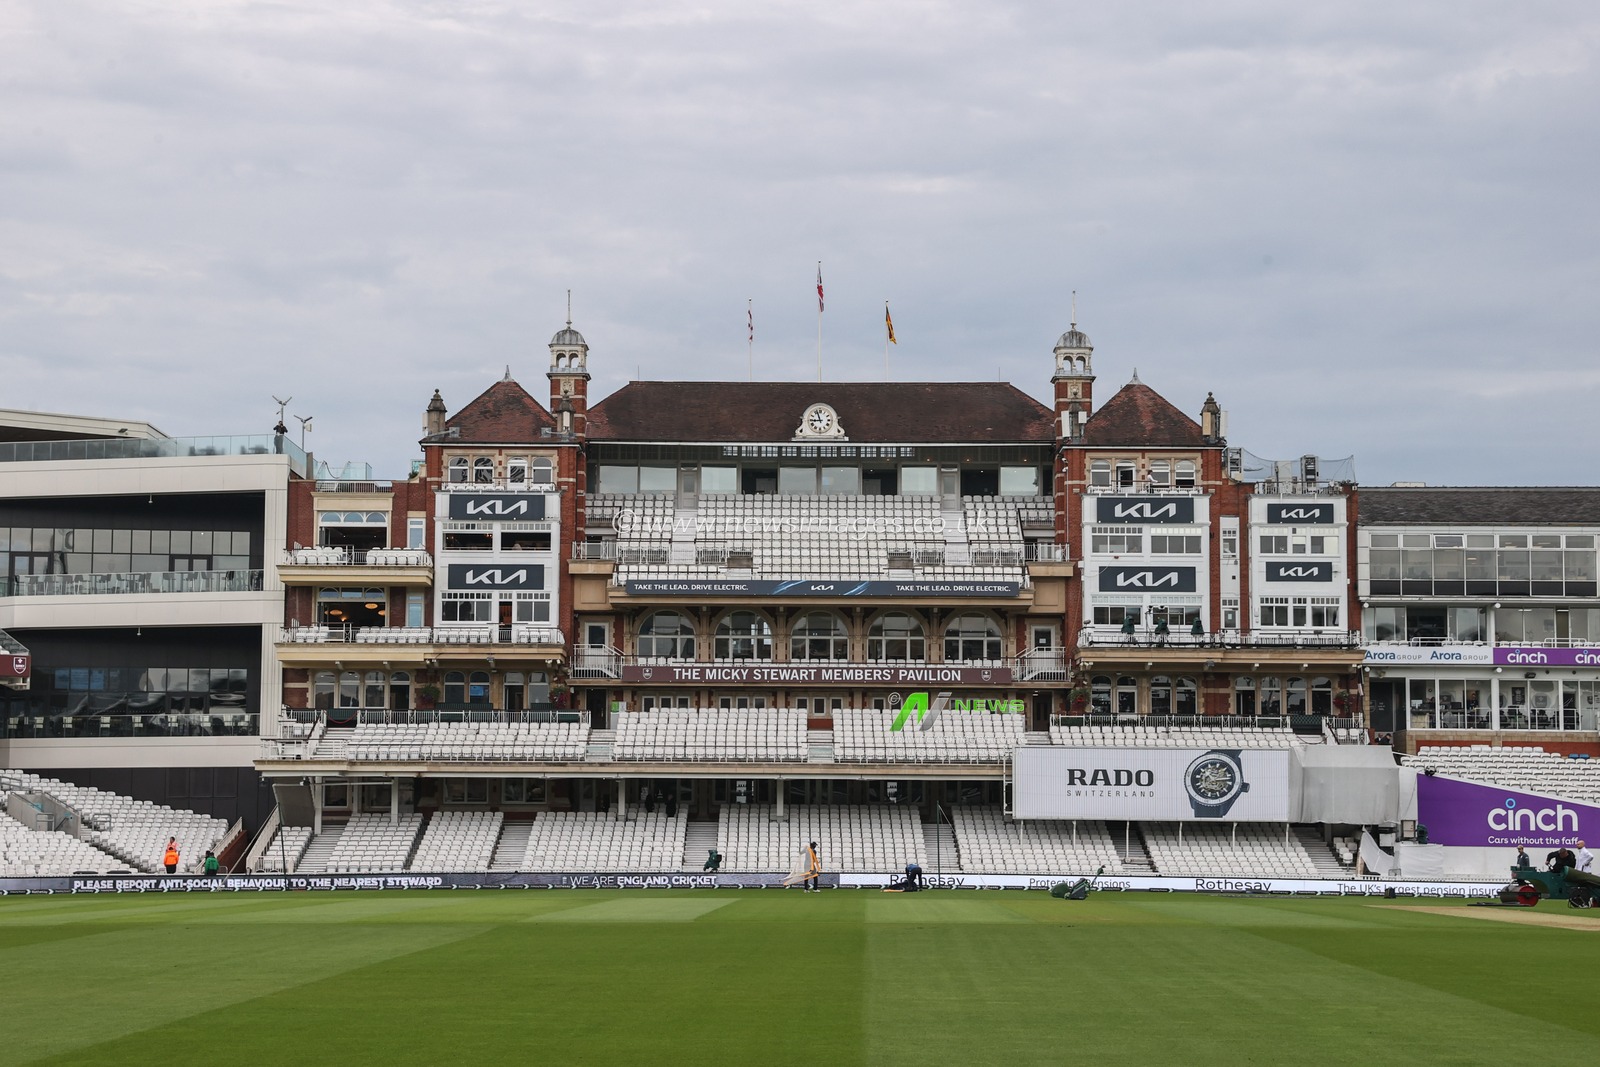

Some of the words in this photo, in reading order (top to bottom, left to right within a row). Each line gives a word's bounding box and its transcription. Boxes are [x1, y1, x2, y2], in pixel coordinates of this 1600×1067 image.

[1364, 650, 1396, 660] Arora
[1430, 650, 1462, 660] Arora
[1507, 649, 1547, 664] cinch
[673, 668, 700, 680] THE
[705, 668, 749, 680] MICKY
[753, 668, 817, 681] STEWART
[821, 669, 894, 681] MEMBERS’
[899, 669, 961, 681] PAVILION
[1067, 769, 1154, 787] RADO
[1067, 789, 1154, 798] SWITZERLAND
[1487, 798, 1579, 832] cinch
[1488, 836, 1509, 844] Cars
[1510, 836, 1544, 845] without
[1545, 837, 1560, 845] the
[73, 880, 114, 889] PLEASE
[116, 880, 157, 889] REPORT
[159, 879, 225, 888] ANTI-SOCIAL
[227, 879, 288, 888] BEHAVIOUR
[291, 878, 307, 888] TO
[309, 878, 332, 887] THE
[333, 877, 385, 887] NEAREST
[387, 877, 442, 886] STEWARD
[570, 876, 589, 885] WE
[591, 876, 615, 885] ARE
[617, 876, 669, 885] ENGLAND
[671, 876, 717, 885] CRICKET
[890, 874, 965, 886] Rohesay
[1029, 878, 1076, 888] Protectin
[1195, 878, 1272, 891] Rothesay
[1337, 883, 1356, 892] The
[1360, 884, 1381, 892] UK’s
[1384, 884, 1420, 894] lrgest
[1423, 885, 1466, 894] pension
